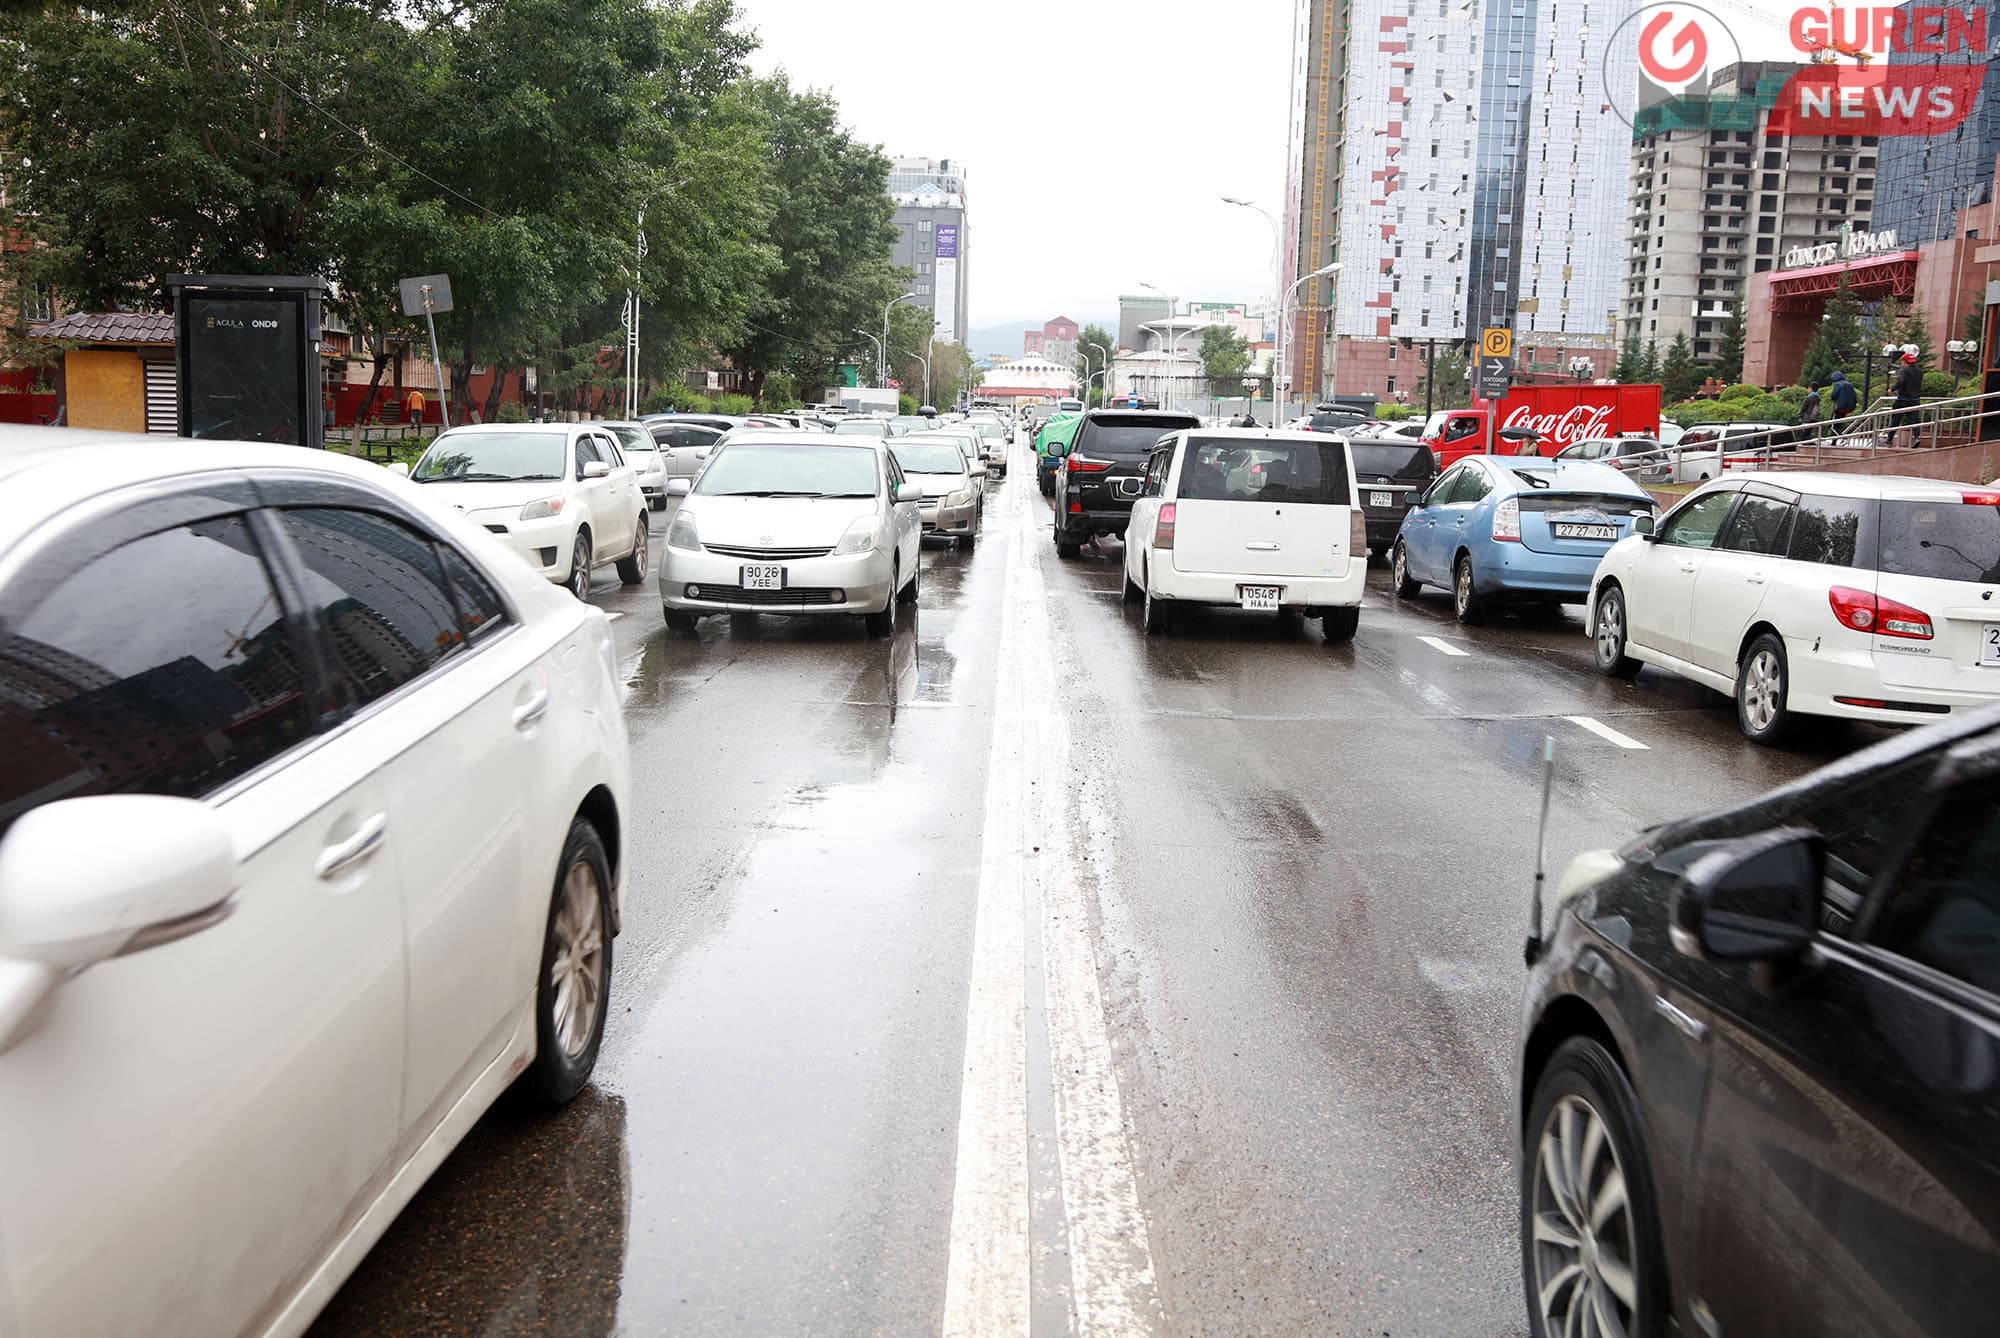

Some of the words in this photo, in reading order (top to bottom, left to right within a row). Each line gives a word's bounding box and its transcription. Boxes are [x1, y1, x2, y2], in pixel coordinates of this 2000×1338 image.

[251, 320, 278, 328] ONDO
[1502, 405, 1616, 442] Coca-Cola
[1247, 588, 1275, 600] 0548
